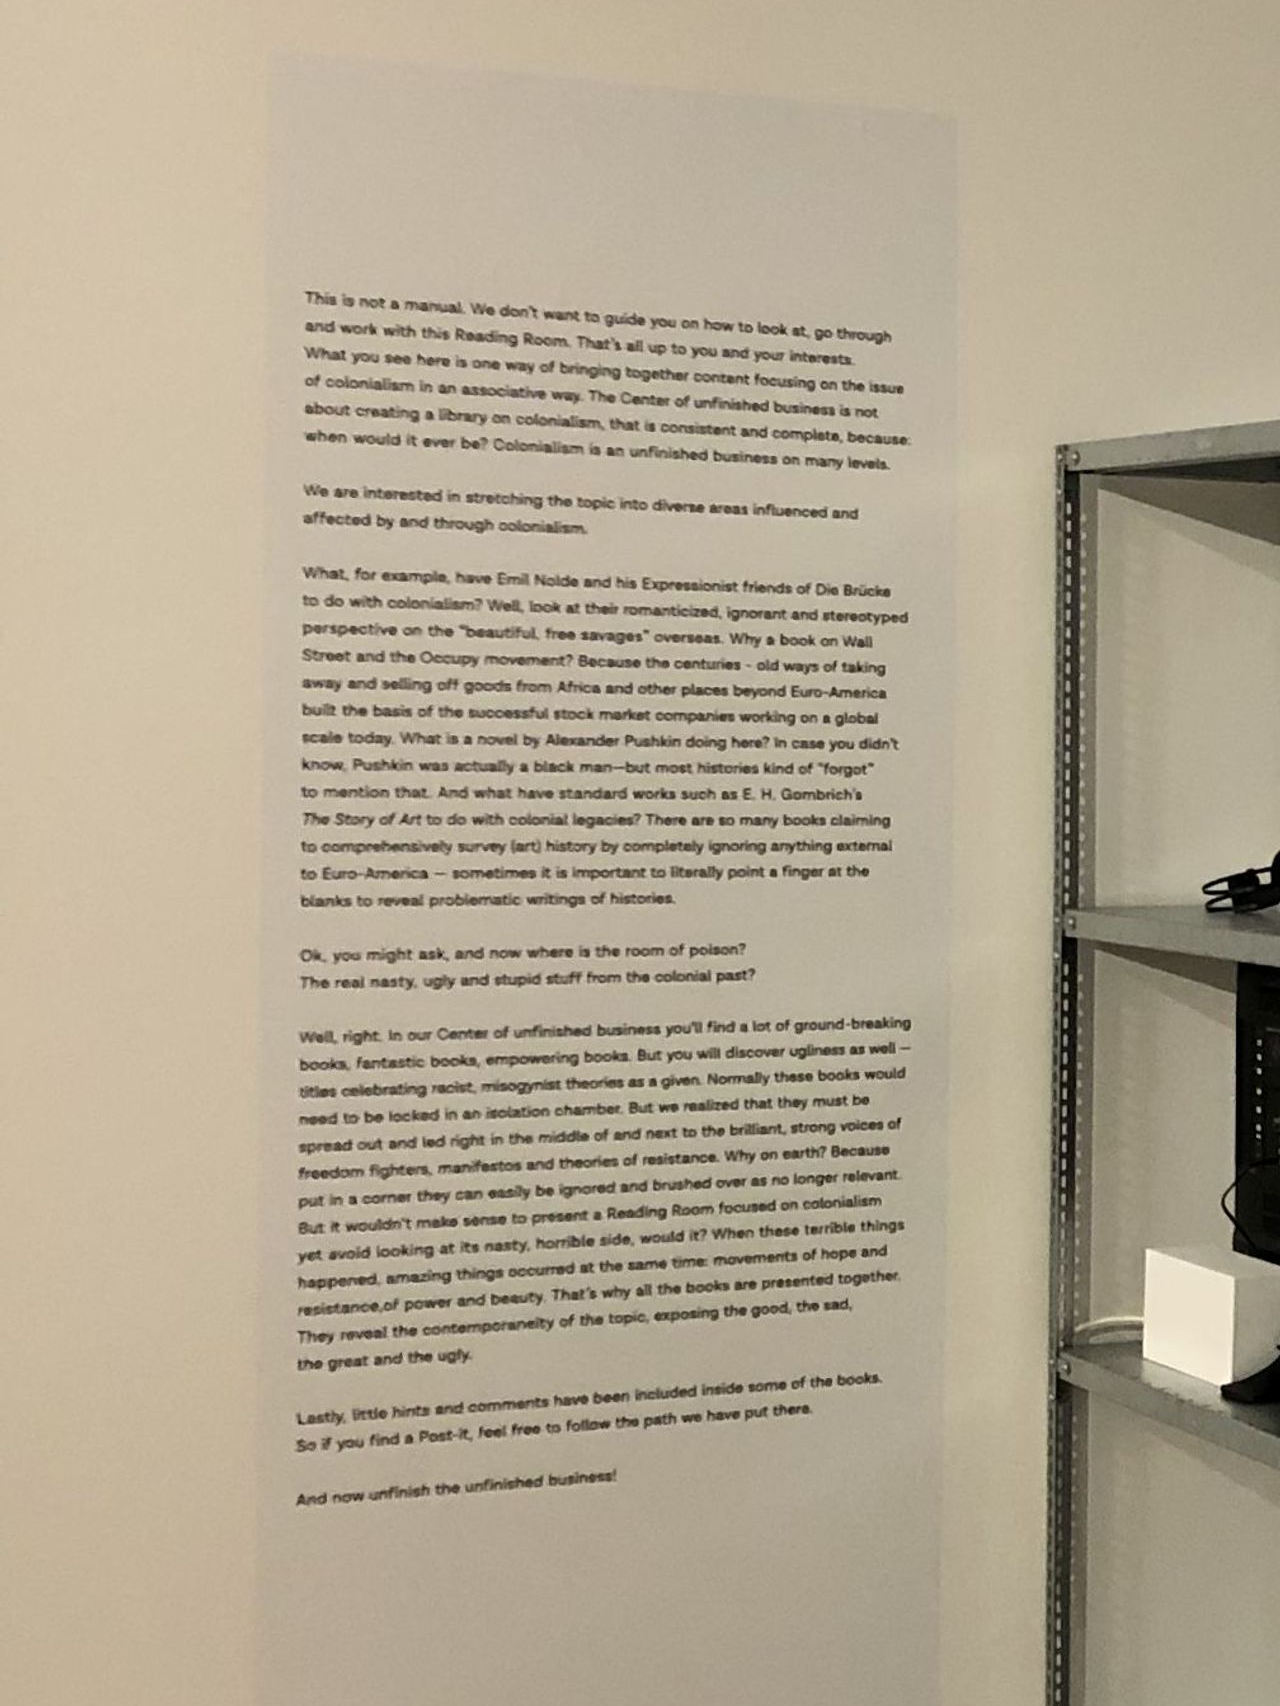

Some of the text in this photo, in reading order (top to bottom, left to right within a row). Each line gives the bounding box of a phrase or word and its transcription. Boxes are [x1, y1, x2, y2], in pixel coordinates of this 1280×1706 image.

[305, 290, 337, 306] This
[341, 293, 354, 307] is
[359, 296, 385, 309] not
[390, 299, 399, 310] a
[404, 297, 464, 314] manual.
[470, 302, 495, 316] We
[543, 308, 580, 322] want
[584, 310, 600, 323] to
[603, 310, 646, 330] guide
[649, 316, 676, 331] you
[680, 319, 699, 330] on
[703, 317, 734, 332] how
[737, 321, 753, 333] to
[756, 321, 788, 336] look
[791, 325, 810, 339] at,
[814, 328, 833, 342] go
[836, 326, 892, 346] through
[305, 319, 335, 333] and
[339, 320, 377, 336] work
[383, 323, 416, 338] with
[421, 326, 450, 341] this
[454, 327, 518, 348] Reading
[522, 331, 570, 348] Room.
[625, 338, 643, 353] all
[647, 343, 667, 356] up
[670, 342, 687, 355] to
[690, 346, 718, 360] you
[721, 345, 750, 360] and
[753, 350, 785, 365] your
[788, 347, 854, 366] interests.
[300, 786, 318, 798] to
[323, 784, 389, 798] mention
[394, 786, 429, 799] that.
[438, 786, 469, 799] And
[473, 786, 512, 799] what
[516, 786, 554, 799] have
[558, 786, 628, 800] standard
[632, 787, 676, 800] works
[680, 787, 716, 800] such
[720, 790, 738, 800] as
[741, 787, 754, 800] E.
[760, 787, 775, 800] H.
[332, 951, 361, 964] you
[366, 947, 412, 964] might
[418, 946, 449, 962] ask,
[454, 946, 484, 960] and
[489, 949, 522, 959] now
[526, 945, 573, 958] where
[578, 944, 590, 958] is
[594, 944, 620, 958] the
[625, 946, 665, 957] room
[668, 942, 685, 956] of
[688, 942, 746, 959] poison?
[296, 1370, 881, 1429] Lastly, little hints and comments have been included inside some of the books.
[296, 1468, 617, 1506] And now unfinish the unfinished business!
